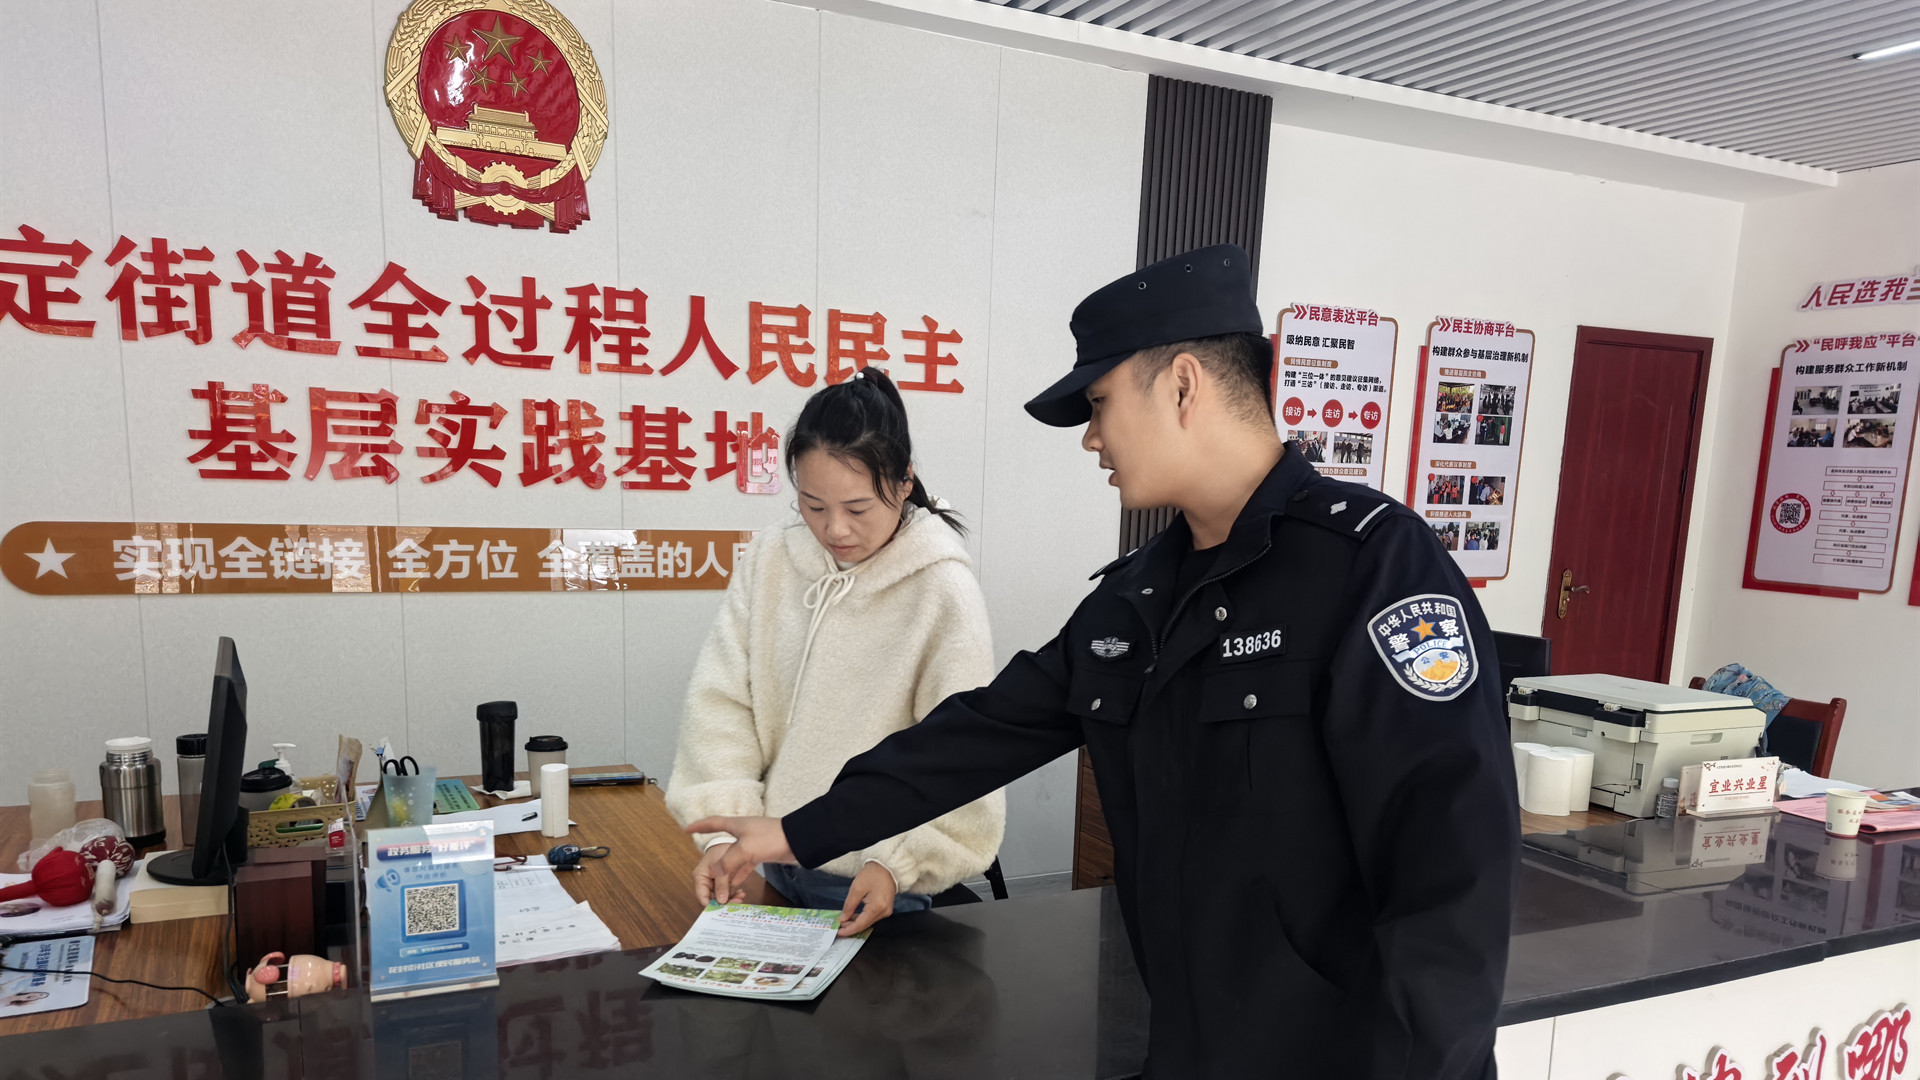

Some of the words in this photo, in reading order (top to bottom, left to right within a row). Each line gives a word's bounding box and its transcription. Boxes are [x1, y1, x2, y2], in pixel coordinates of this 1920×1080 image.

[1309, 306, 1379, 327] 民意表达平台
[1452, 319, 1516, 338] 民主协商平台
[1286, 334, 1320, 347] 吸纳民意
[1322, 337, 1356, 350] 汇聚民智
[1432, 345, 1529, 363] 构建群众参与基层治理新机制
[1796, 361, 1908, 376] 构建服务群众工作新机制
[1285, 406, 1302, 417] 接访
[1325, 408, 1341, 419] 走访
[1363, 410, 1378, 421] 专访
[187, 380, 783, 494] 基层实践基地
[112, 536, 366, 582] 实现全链接
[386, 541, 518, 581] 全方位
[1378, 601, 1457, 637] 中华人民共和国
[1222, 628, 1282, 658] 138636
[1413, 640, 1448, 655] POLICE
